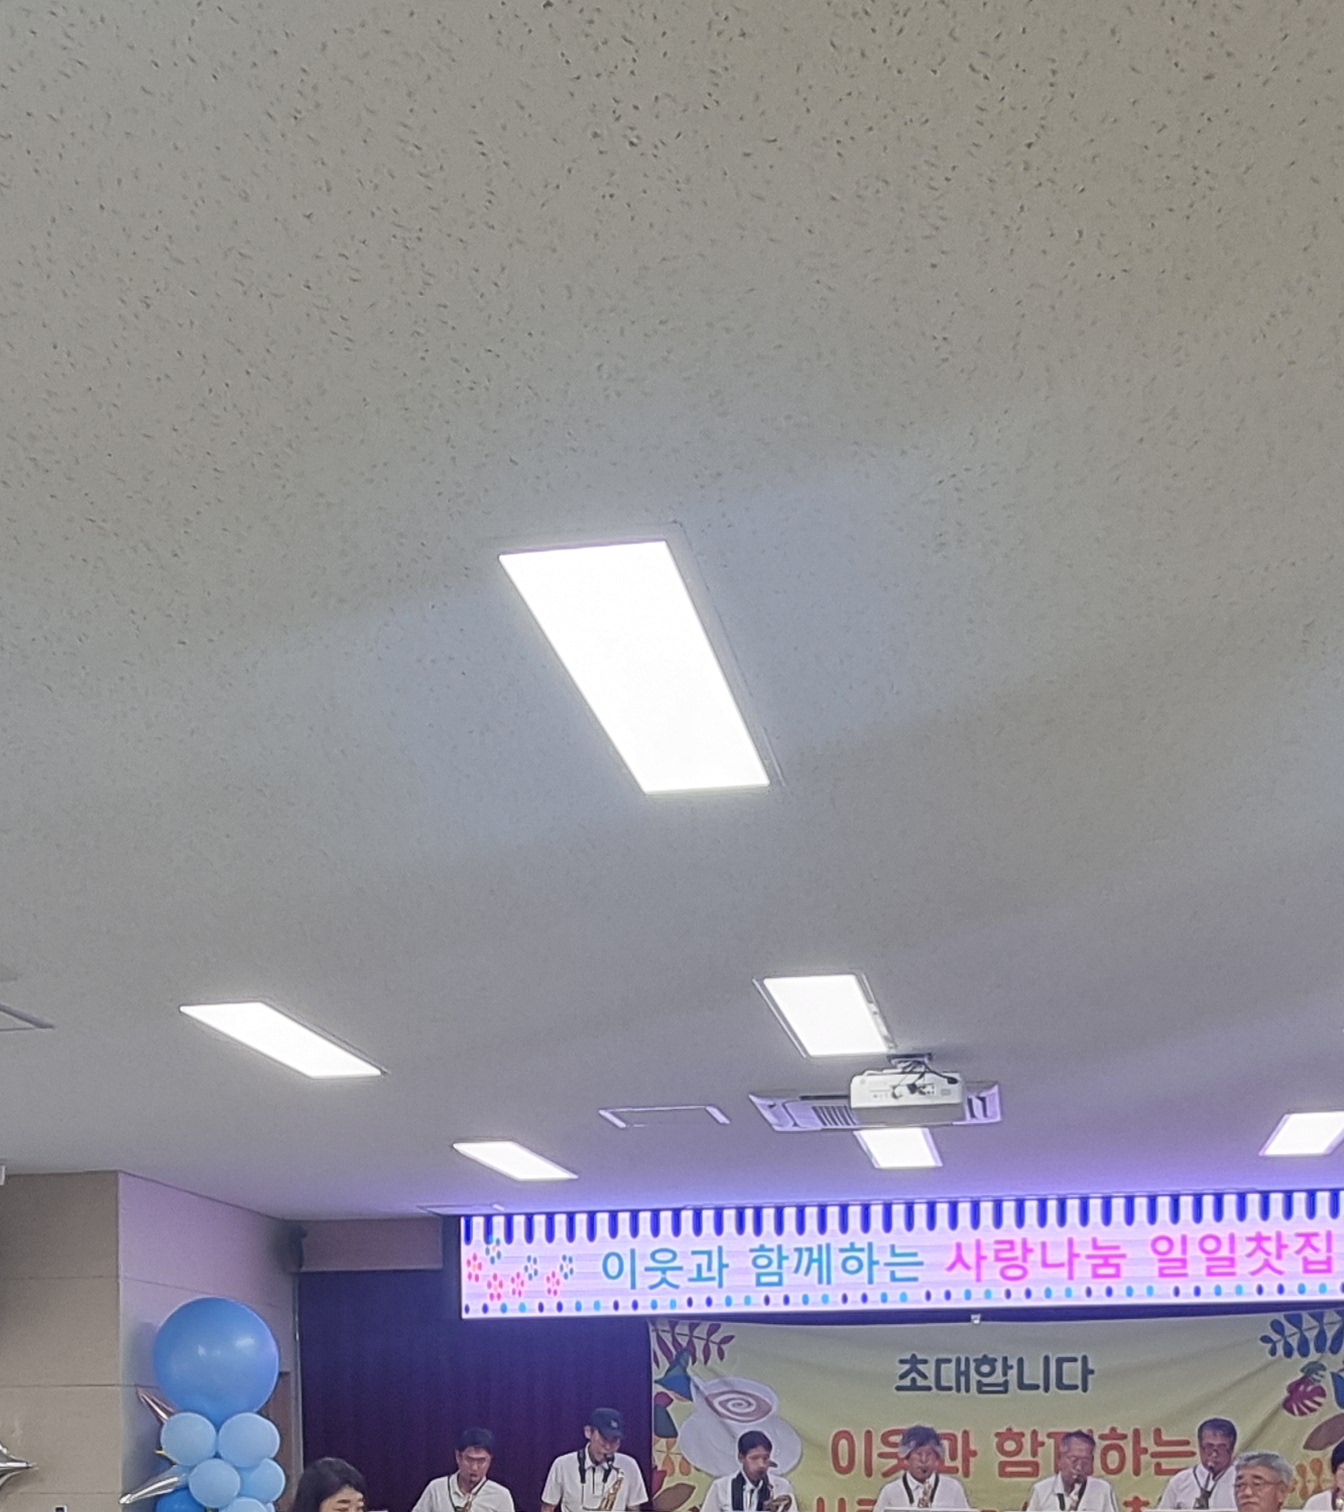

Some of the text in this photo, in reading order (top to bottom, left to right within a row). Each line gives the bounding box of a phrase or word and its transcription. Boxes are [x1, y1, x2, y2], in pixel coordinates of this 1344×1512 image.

[601, 1229, 1336, 1290] 이웃과 함께하는 사랑나눔 일일찻집
[894, 1352, 1096, 1395] 초대합니다
